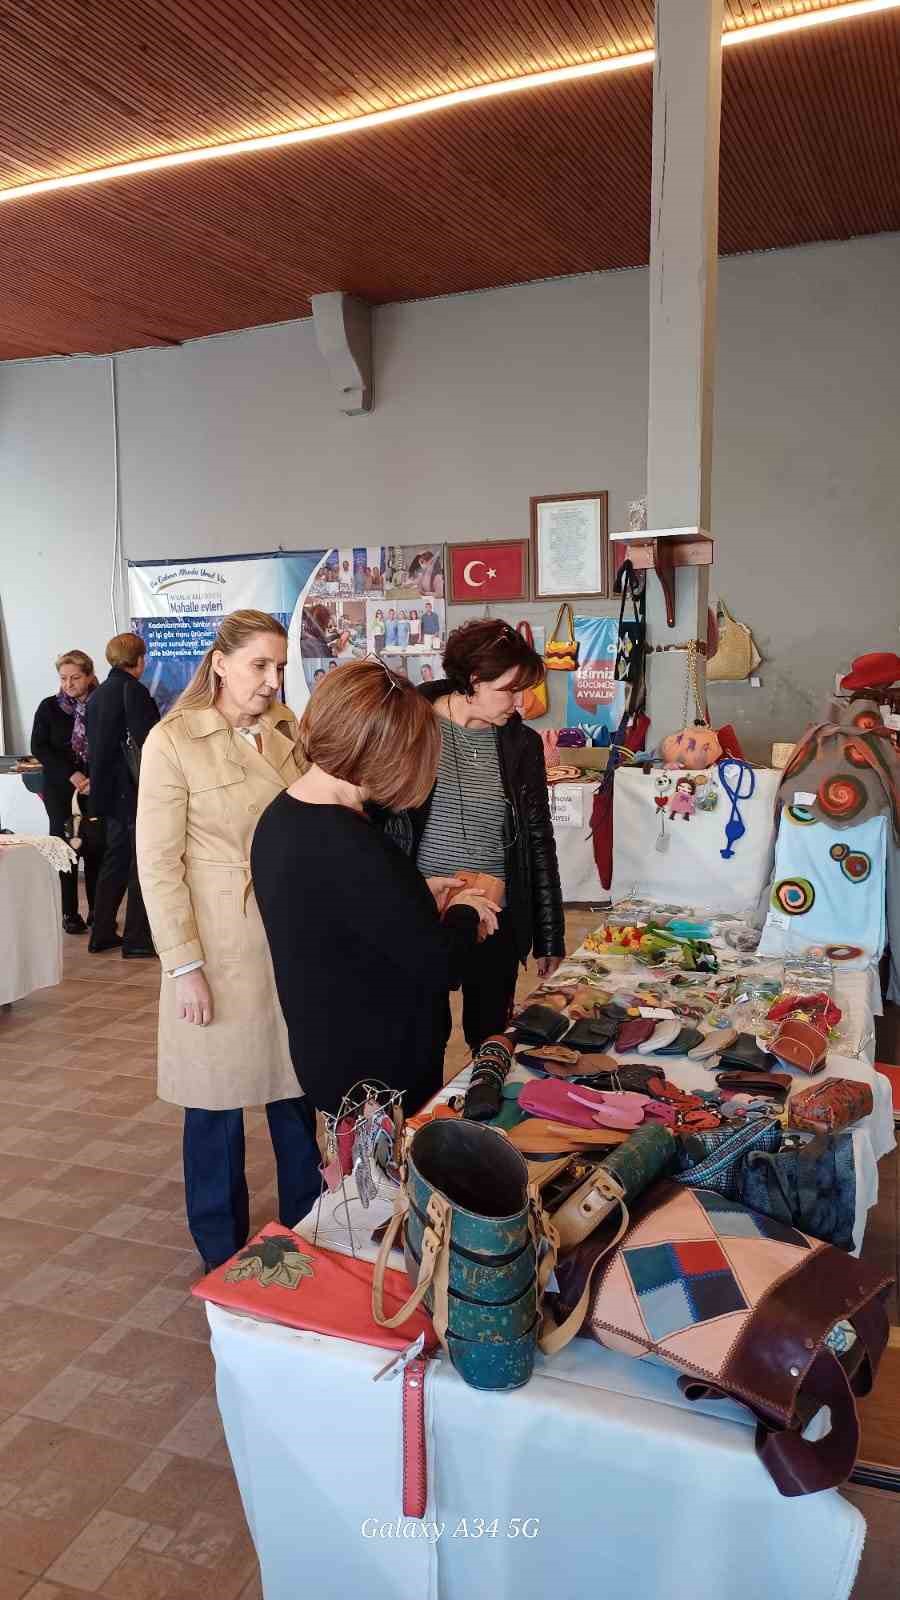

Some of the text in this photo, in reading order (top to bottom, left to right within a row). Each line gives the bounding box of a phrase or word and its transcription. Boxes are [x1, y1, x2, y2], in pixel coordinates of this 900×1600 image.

[170, 600, 223, 613] Mahalle evleri
[577, 690, 615, 699] AYVALIK
